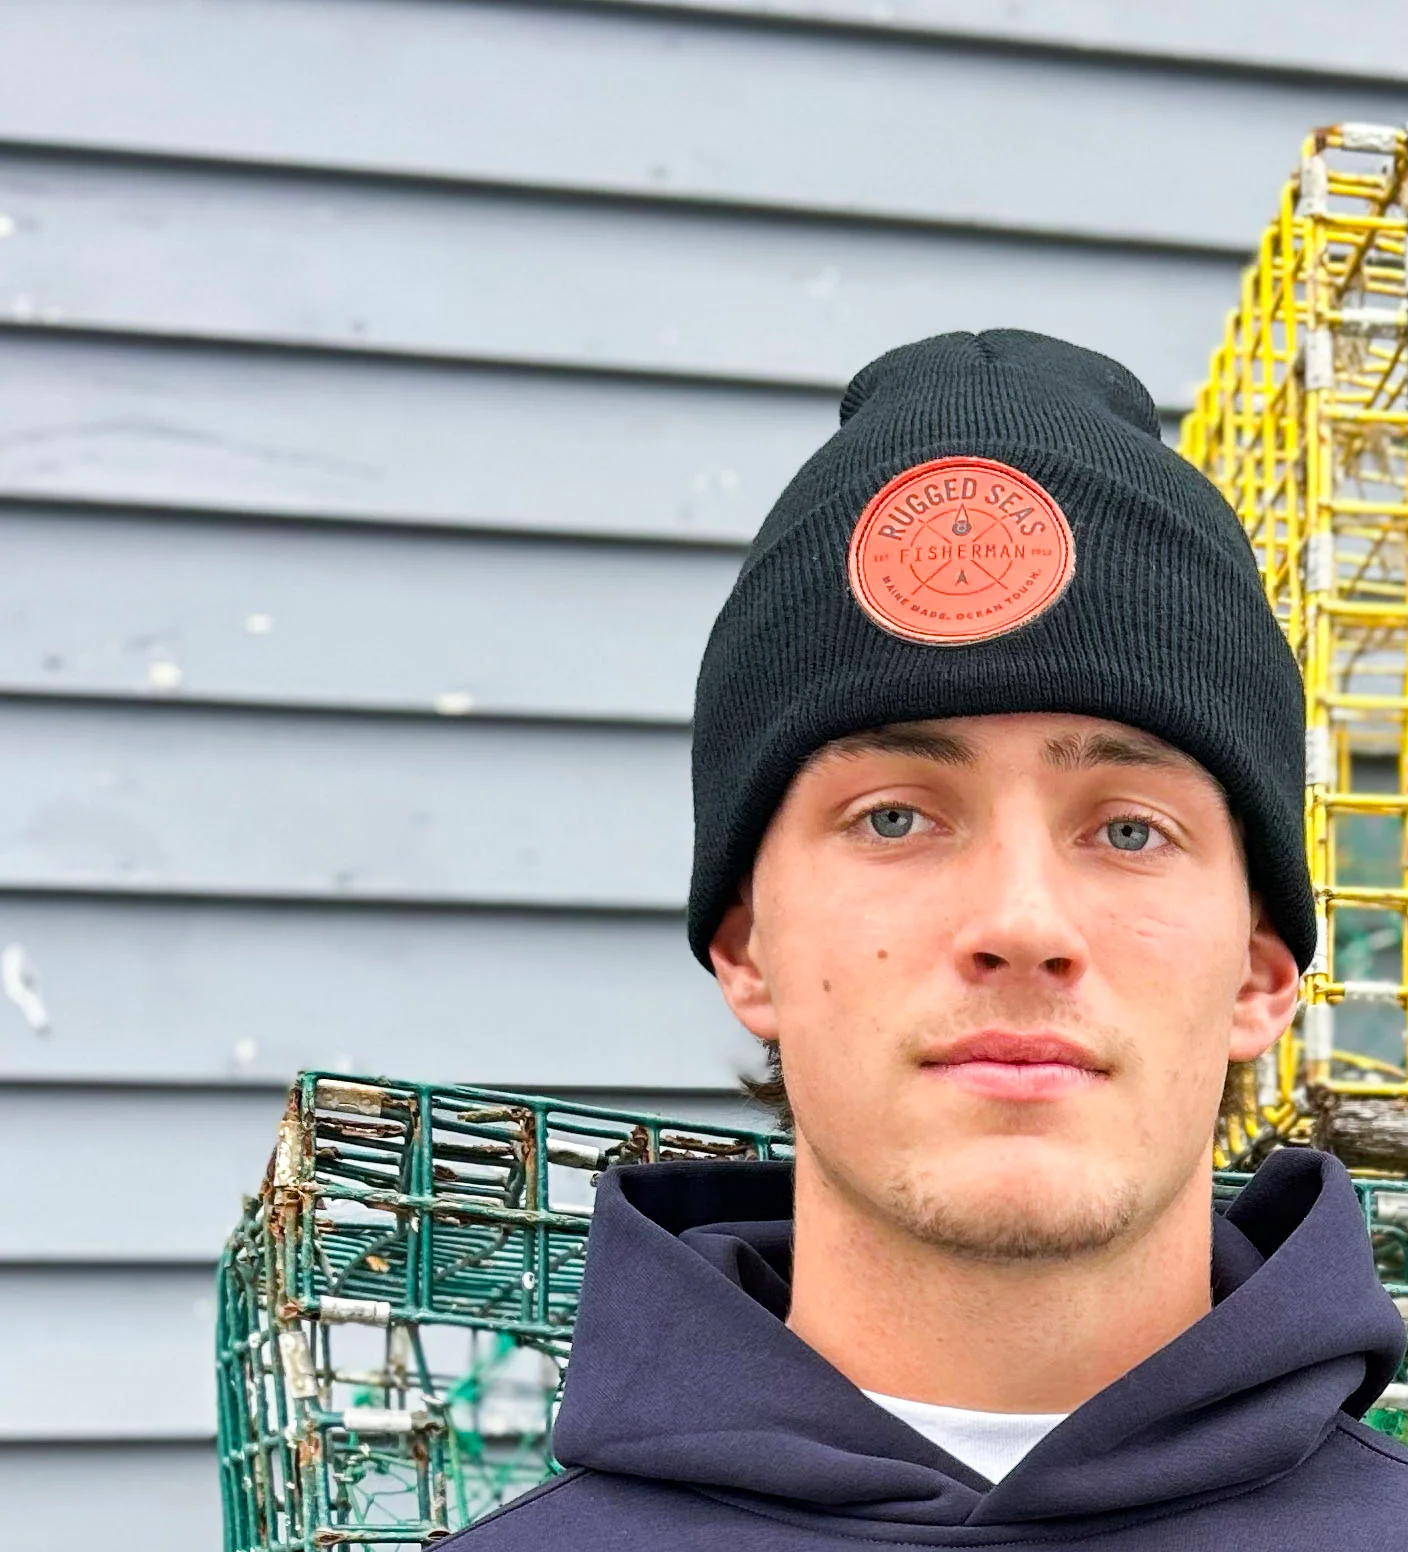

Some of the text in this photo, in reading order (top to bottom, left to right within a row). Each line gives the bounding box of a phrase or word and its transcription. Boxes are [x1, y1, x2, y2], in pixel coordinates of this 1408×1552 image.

[878, 477, 1046, 541] RUGGED SEAS
[900, 544, 1025, 564] FISHERMAN
